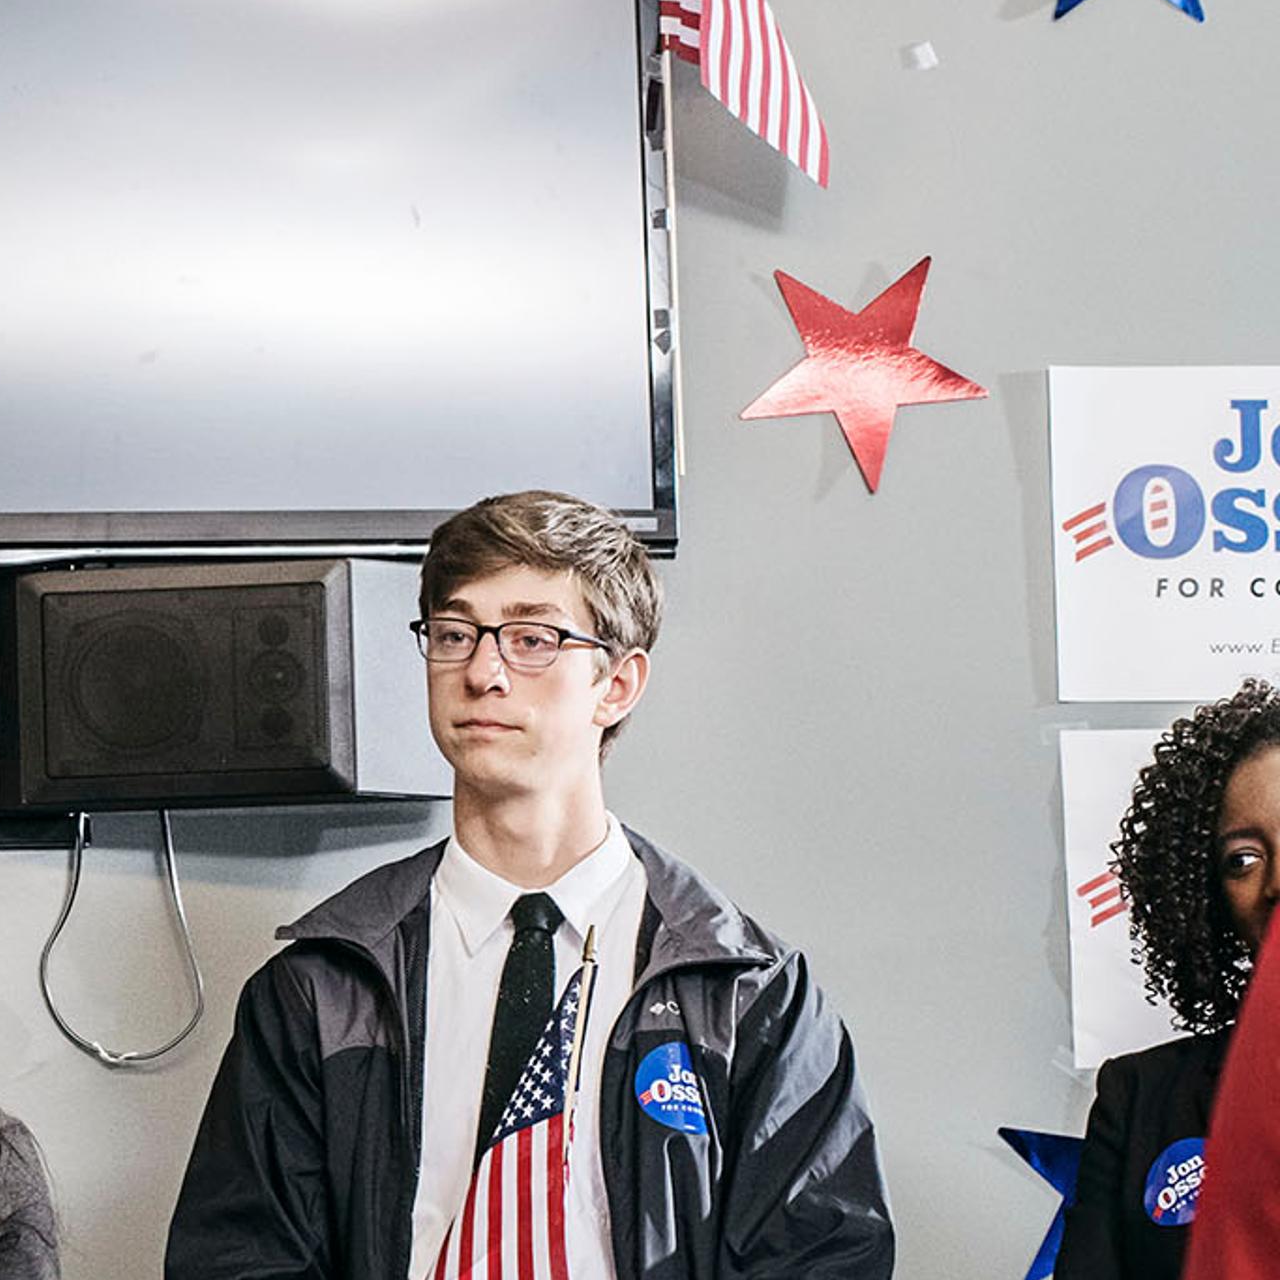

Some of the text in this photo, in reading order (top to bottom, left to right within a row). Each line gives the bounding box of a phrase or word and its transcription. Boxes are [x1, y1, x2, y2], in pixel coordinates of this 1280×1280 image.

[1213, 399, 1280, 474] J
[1113, 464, 1280, 559] Os
[1155, 578, 1280, 598] FOR C
